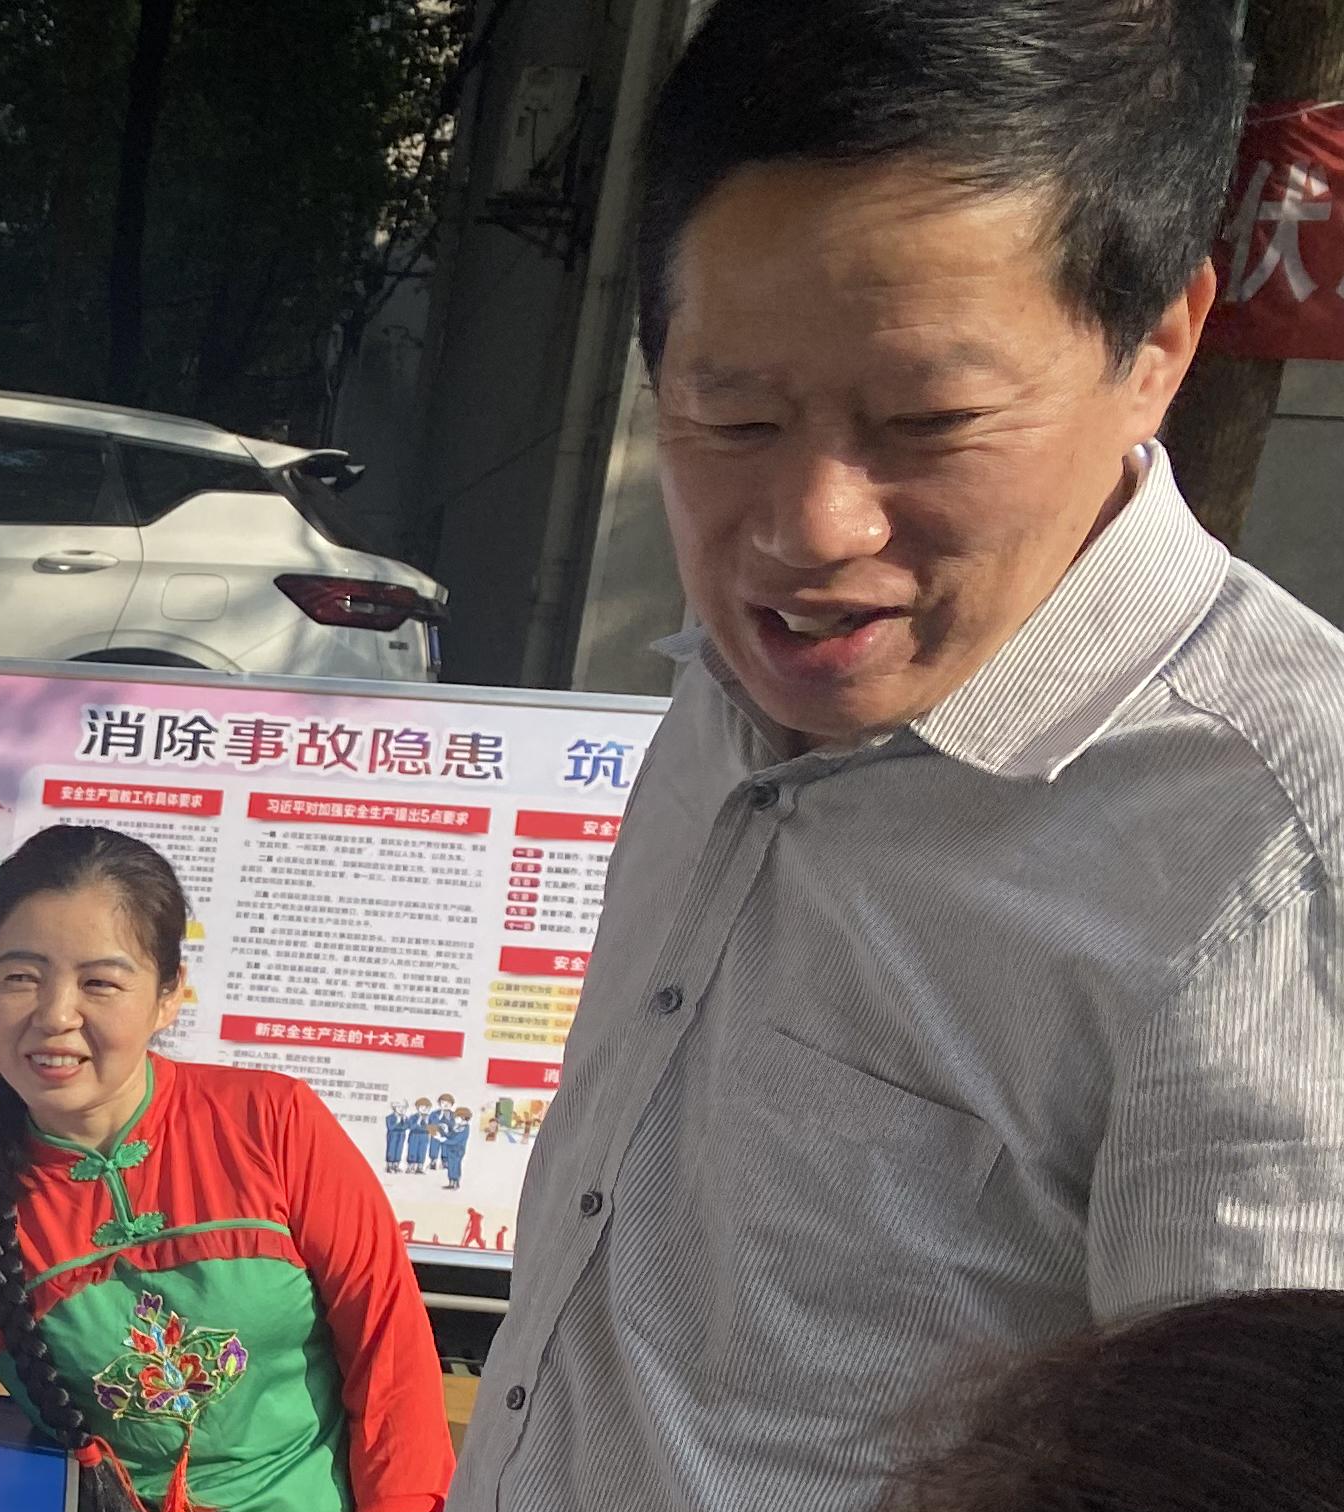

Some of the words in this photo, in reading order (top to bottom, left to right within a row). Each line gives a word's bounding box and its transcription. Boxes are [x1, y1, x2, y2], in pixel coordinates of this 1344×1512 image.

[82, 708, 504, 781] 消除事故隐患
[563, 737, 635, 789] 筑
[266, 798, 470, 826] 习近平对加强安全生产提出5点要求
[255, 1022, 425, 1049] 新安全生产法的十大亮点
